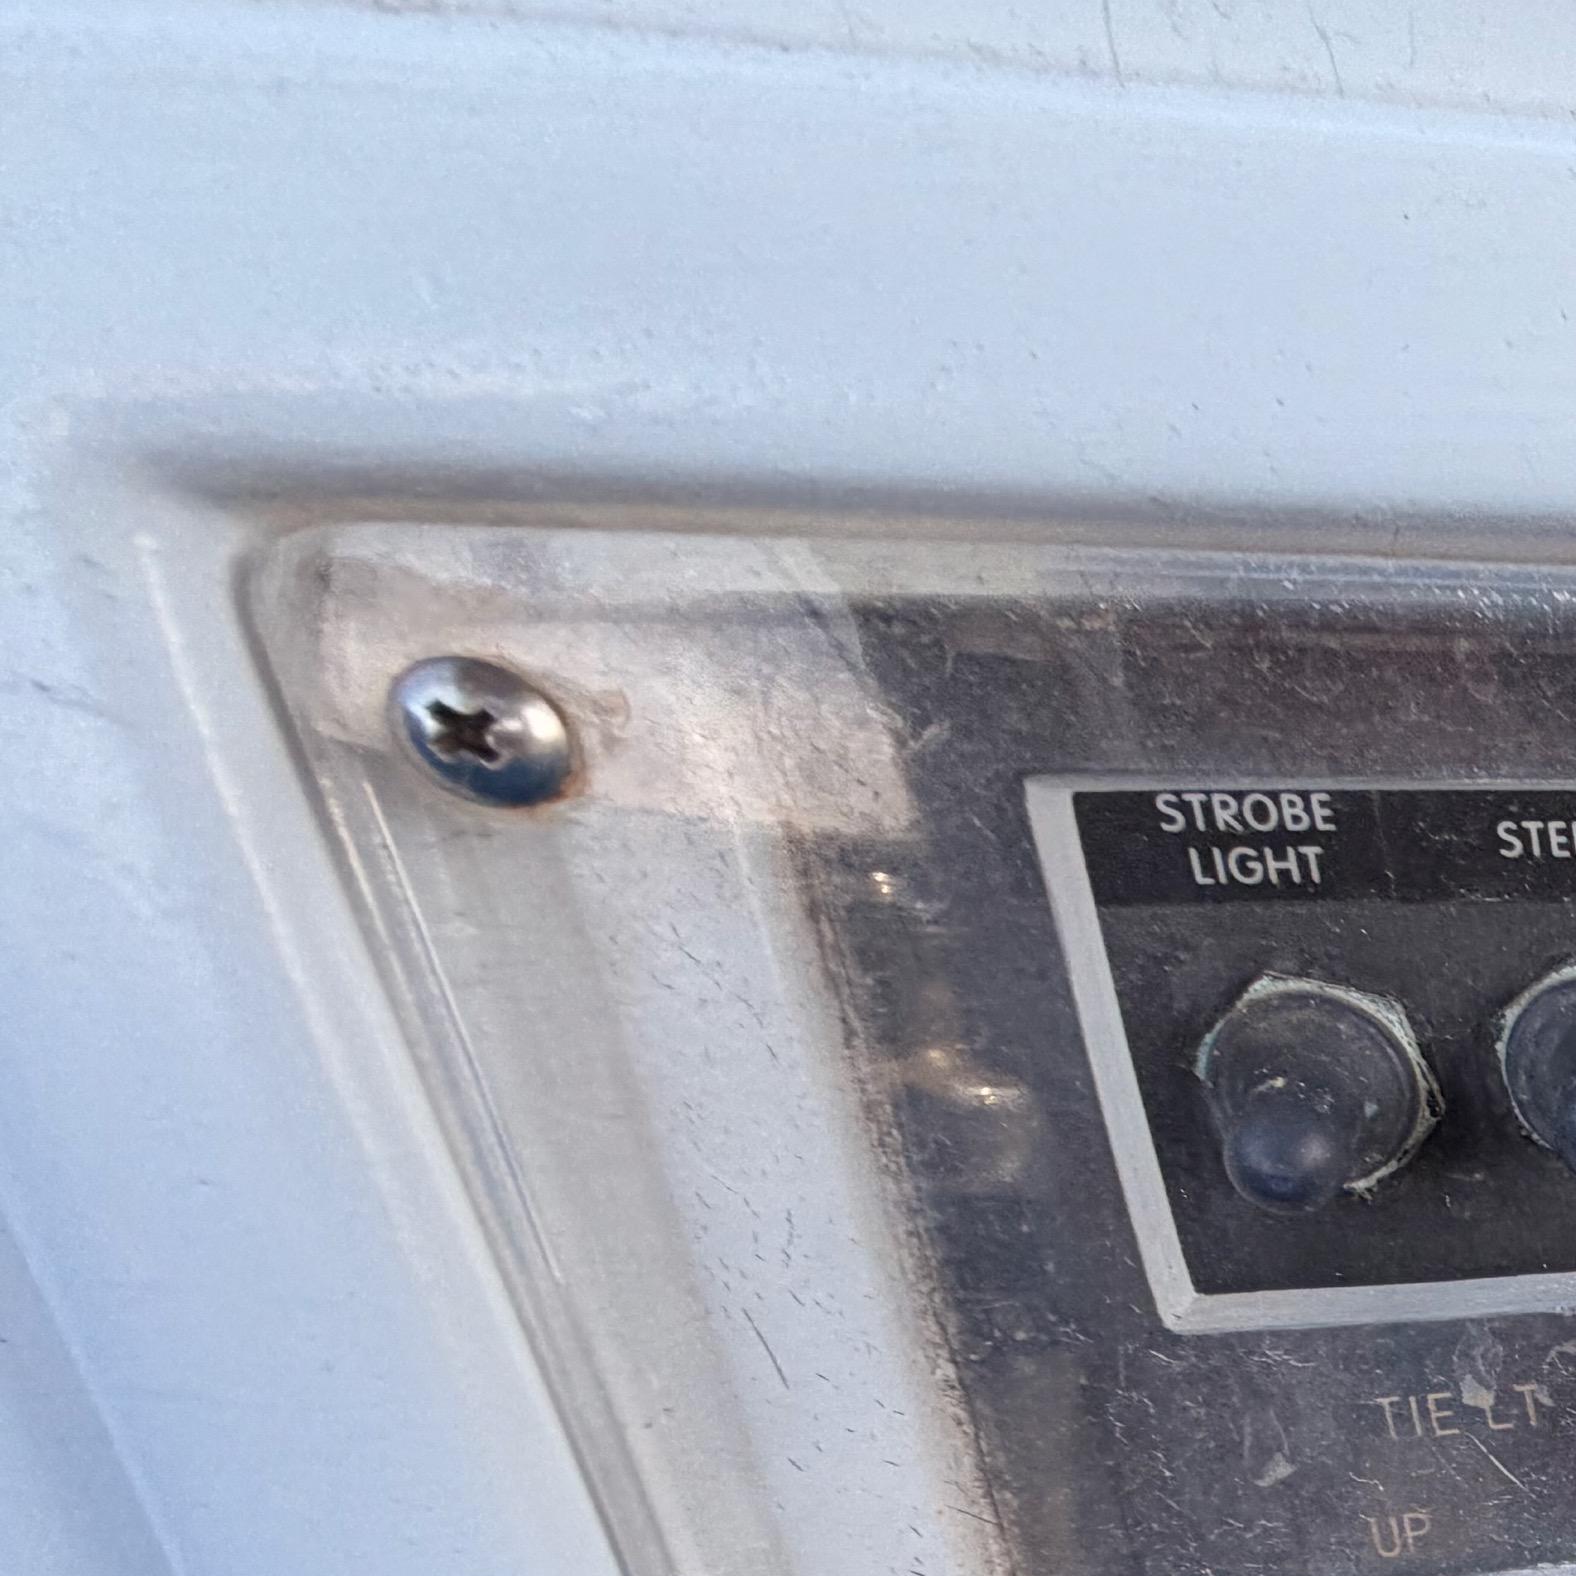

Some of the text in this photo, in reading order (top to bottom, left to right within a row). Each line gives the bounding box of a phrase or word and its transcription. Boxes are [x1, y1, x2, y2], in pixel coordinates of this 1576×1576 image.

[1154, 792, 1338, 834] STROBE
[1187, 845, 1324, 886] LIGHT
[1374, 1392, 1461, 1441] TIE
[1367, 1511, 1433, 1559] UP
